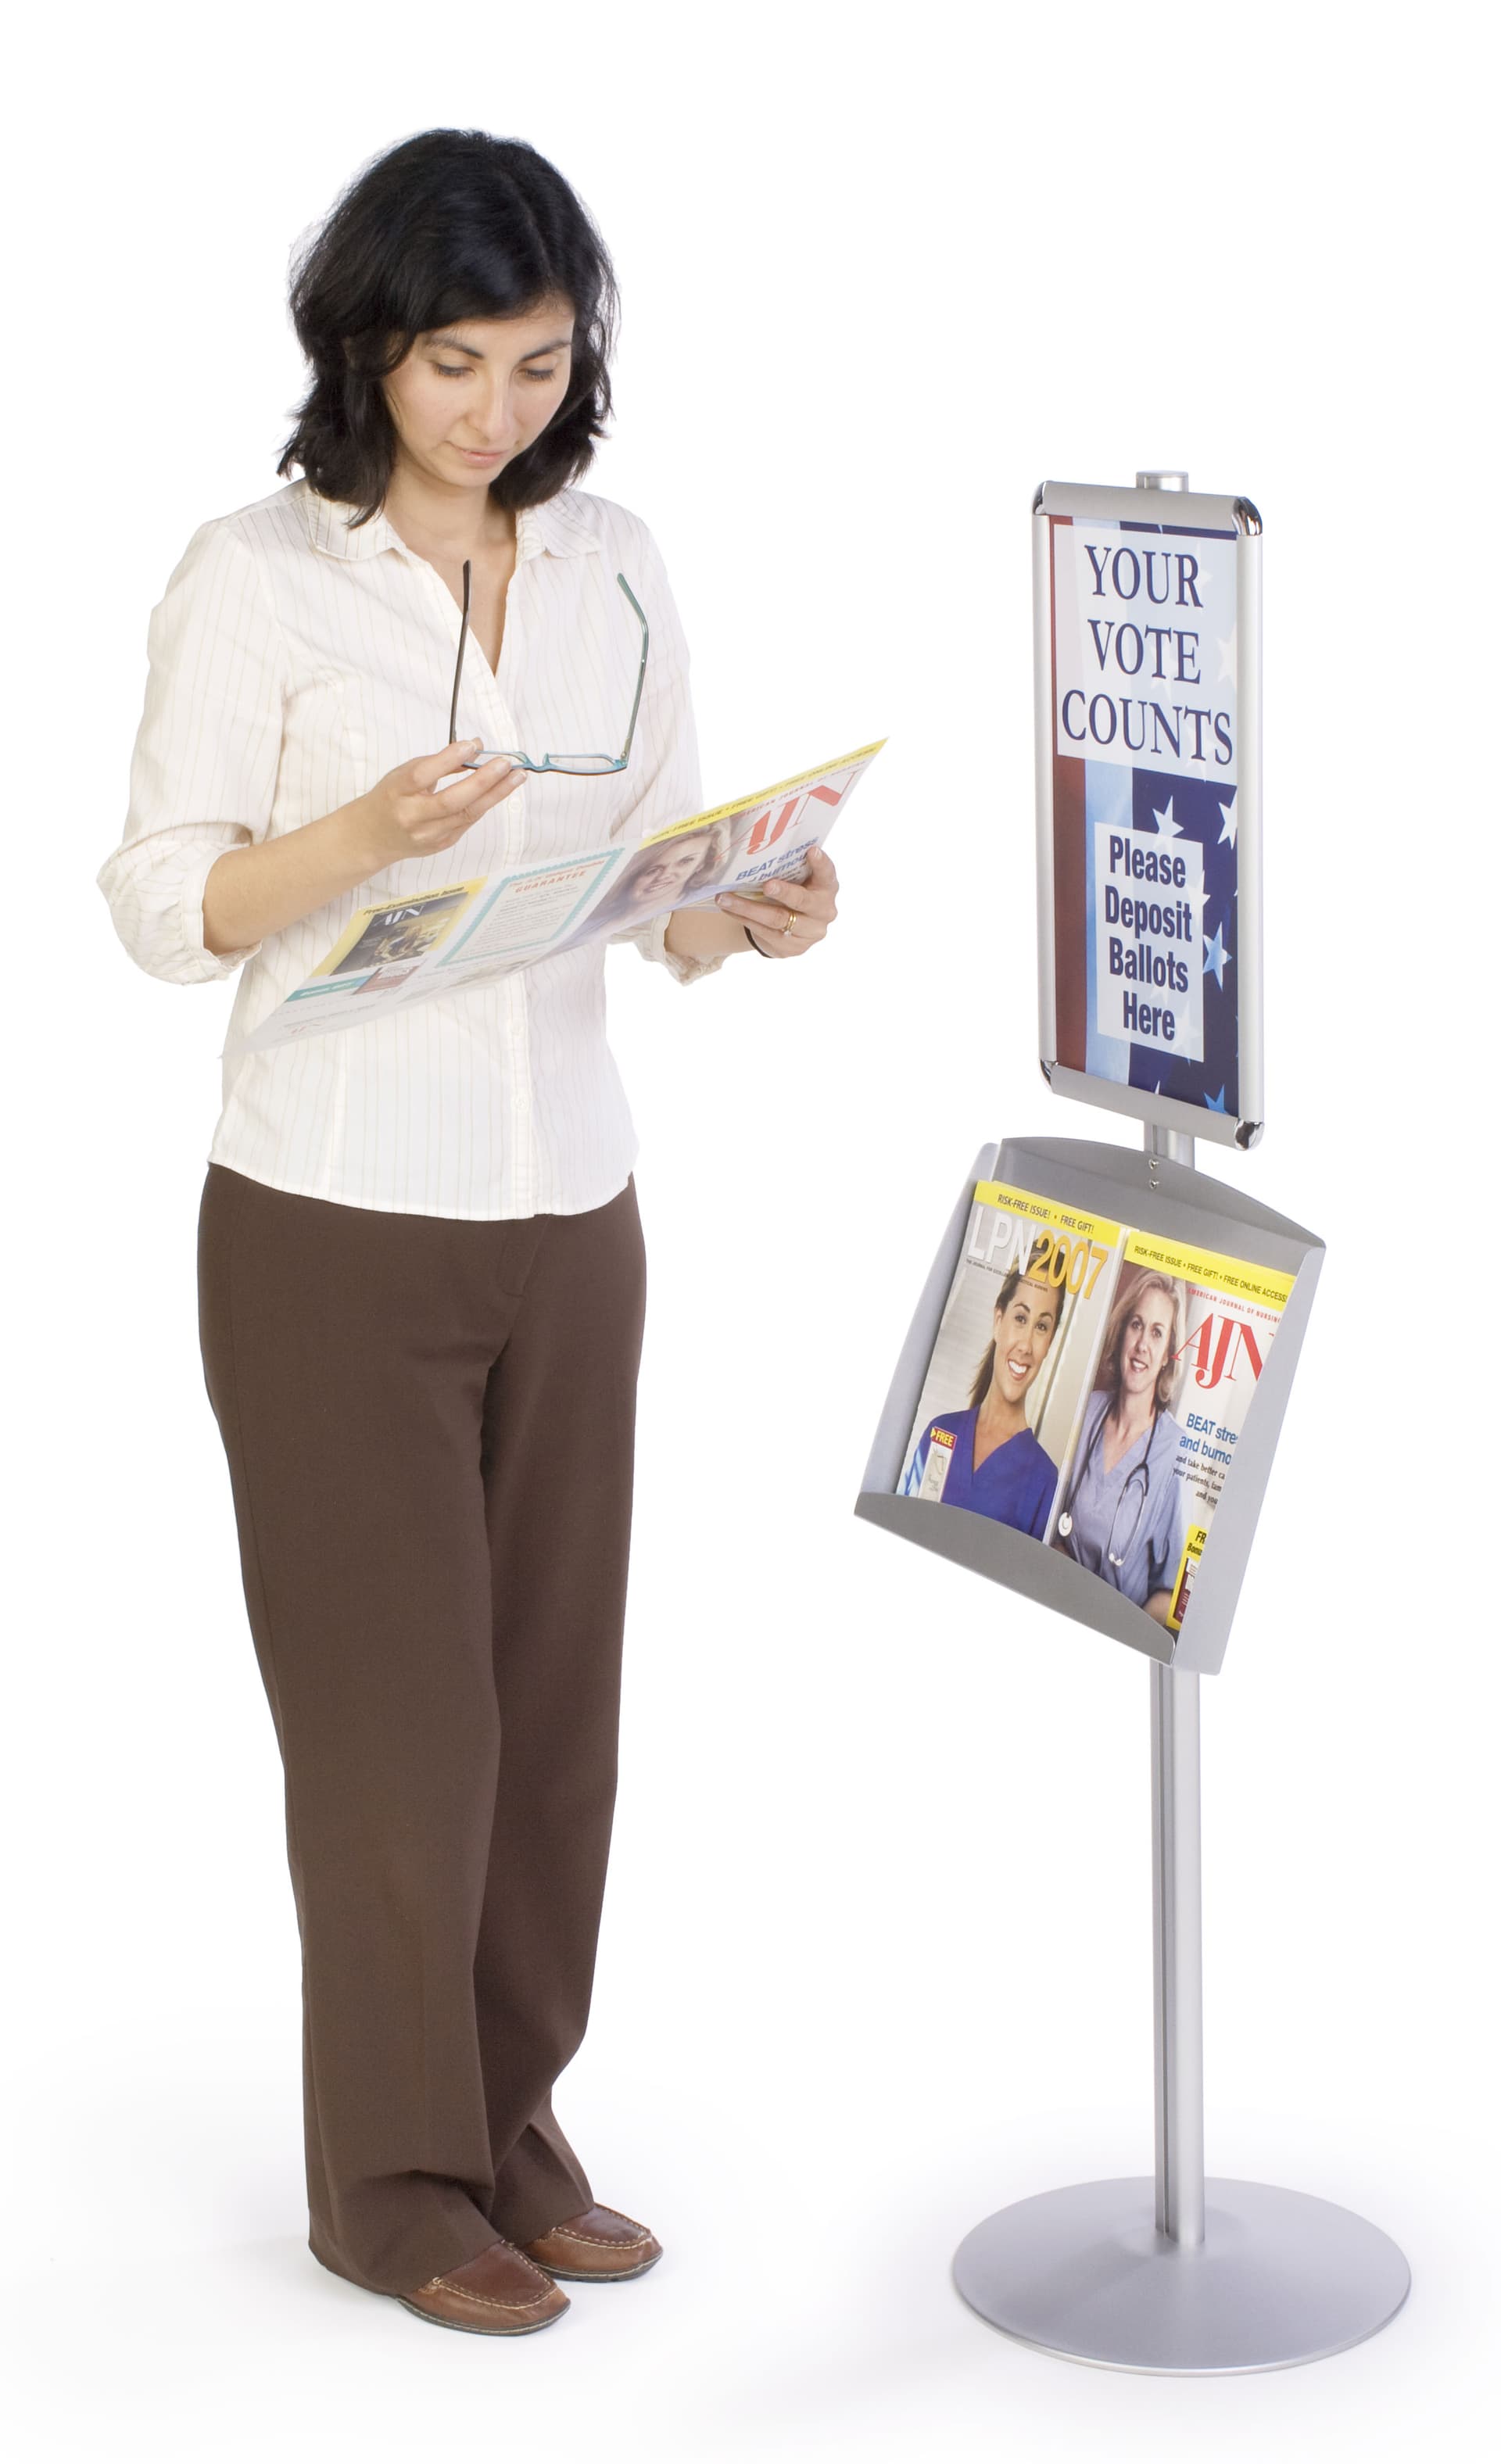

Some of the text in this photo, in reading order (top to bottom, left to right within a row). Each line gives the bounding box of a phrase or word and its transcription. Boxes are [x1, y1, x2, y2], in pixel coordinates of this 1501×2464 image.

[1084, 544, 1203, 607] YOUR
[1087, 618, 1201, 685] VOTE
[1062, 689, 1234, 766] COUNTS
[736, 857, 777, 881] BEAT
[1109, 833, 1186, 889] Please
[1105, 884, 1192, 944] Deposit
[1109, 935, 1189, 993] Ballots
[1123, 990, 1176, 1041] Here
[998, 1194, 1094, 1234] RISK-FREE ISSUE! FREE GIFT!
[1134, 1245, 1164, 1262] RISK-FREE
[1165, 1255, 1182, 1268] ISSUE
[1187, 1262, 1202, 1275] FREE
[1203, 1266, 1220, 1280] GIFT!
[1223, 1275, 1239, 1287] FREE
[1240, 1279, 1261, 1295] ONLINE
[1220, 1298, 1245, 1312] JOURNAL
[1171, 1313, 1275, 1389] AJN
[935, 1430, 955, 1446] FREE
[1180, 1435, 1201, 1452] and
[1186, 1413, 1238, 1445] BEAT stre
[1176, 1455, 1187, 1464] and
[1188, 1458, 1200, 1470] take
[1200, 1463, 1218, 1477] better
[1195, 1530, 1207, 1544] FR
